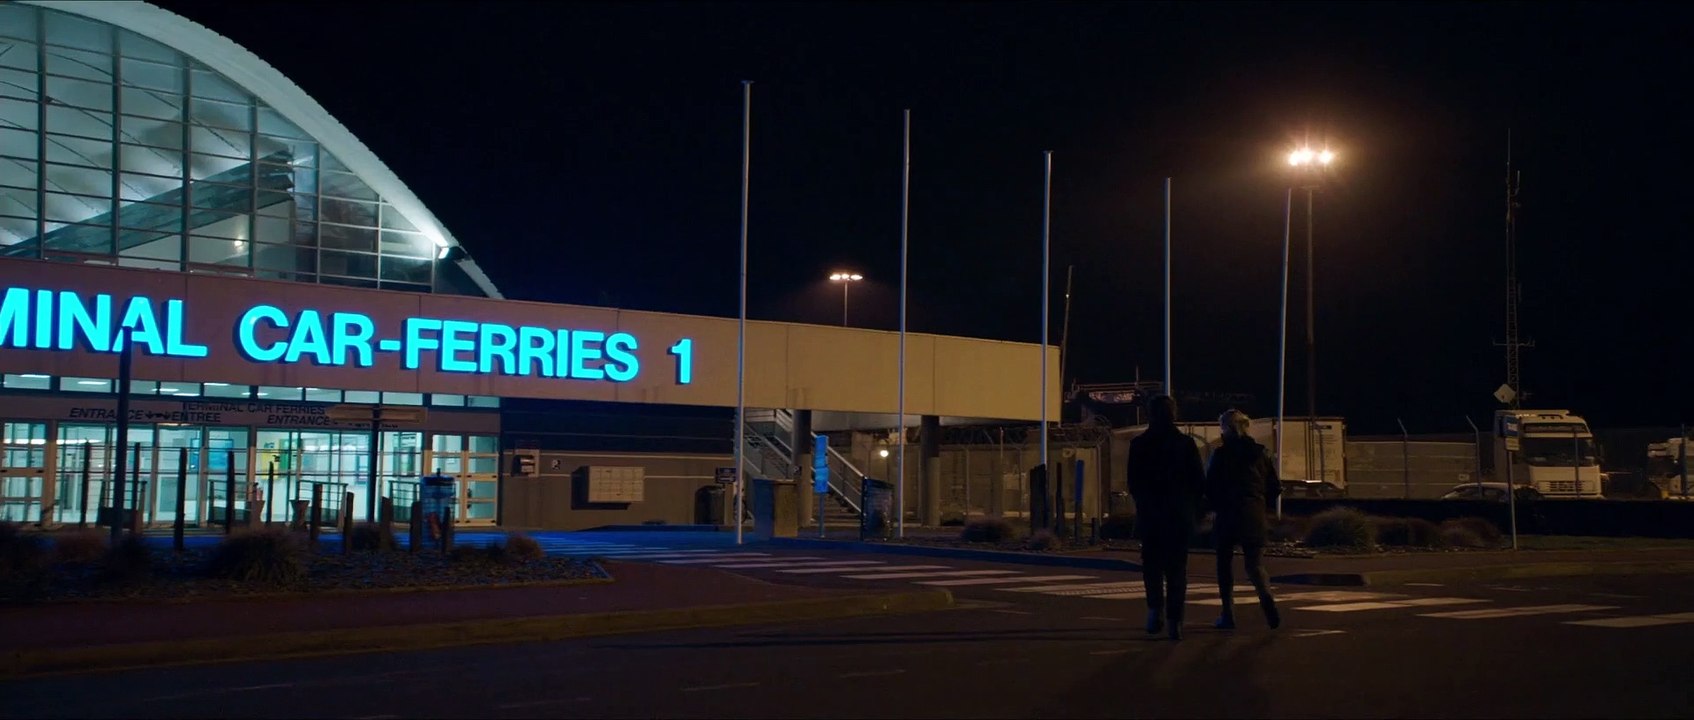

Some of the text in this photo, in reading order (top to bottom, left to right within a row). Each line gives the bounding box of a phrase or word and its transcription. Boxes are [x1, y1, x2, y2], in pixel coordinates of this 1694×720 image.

[0, 287, 693, 384] MINAL CAR-FERRIES 1
[69, 407, 145, 420] ENTRACE
[267, 414, 329, 426] ENTRANCE
